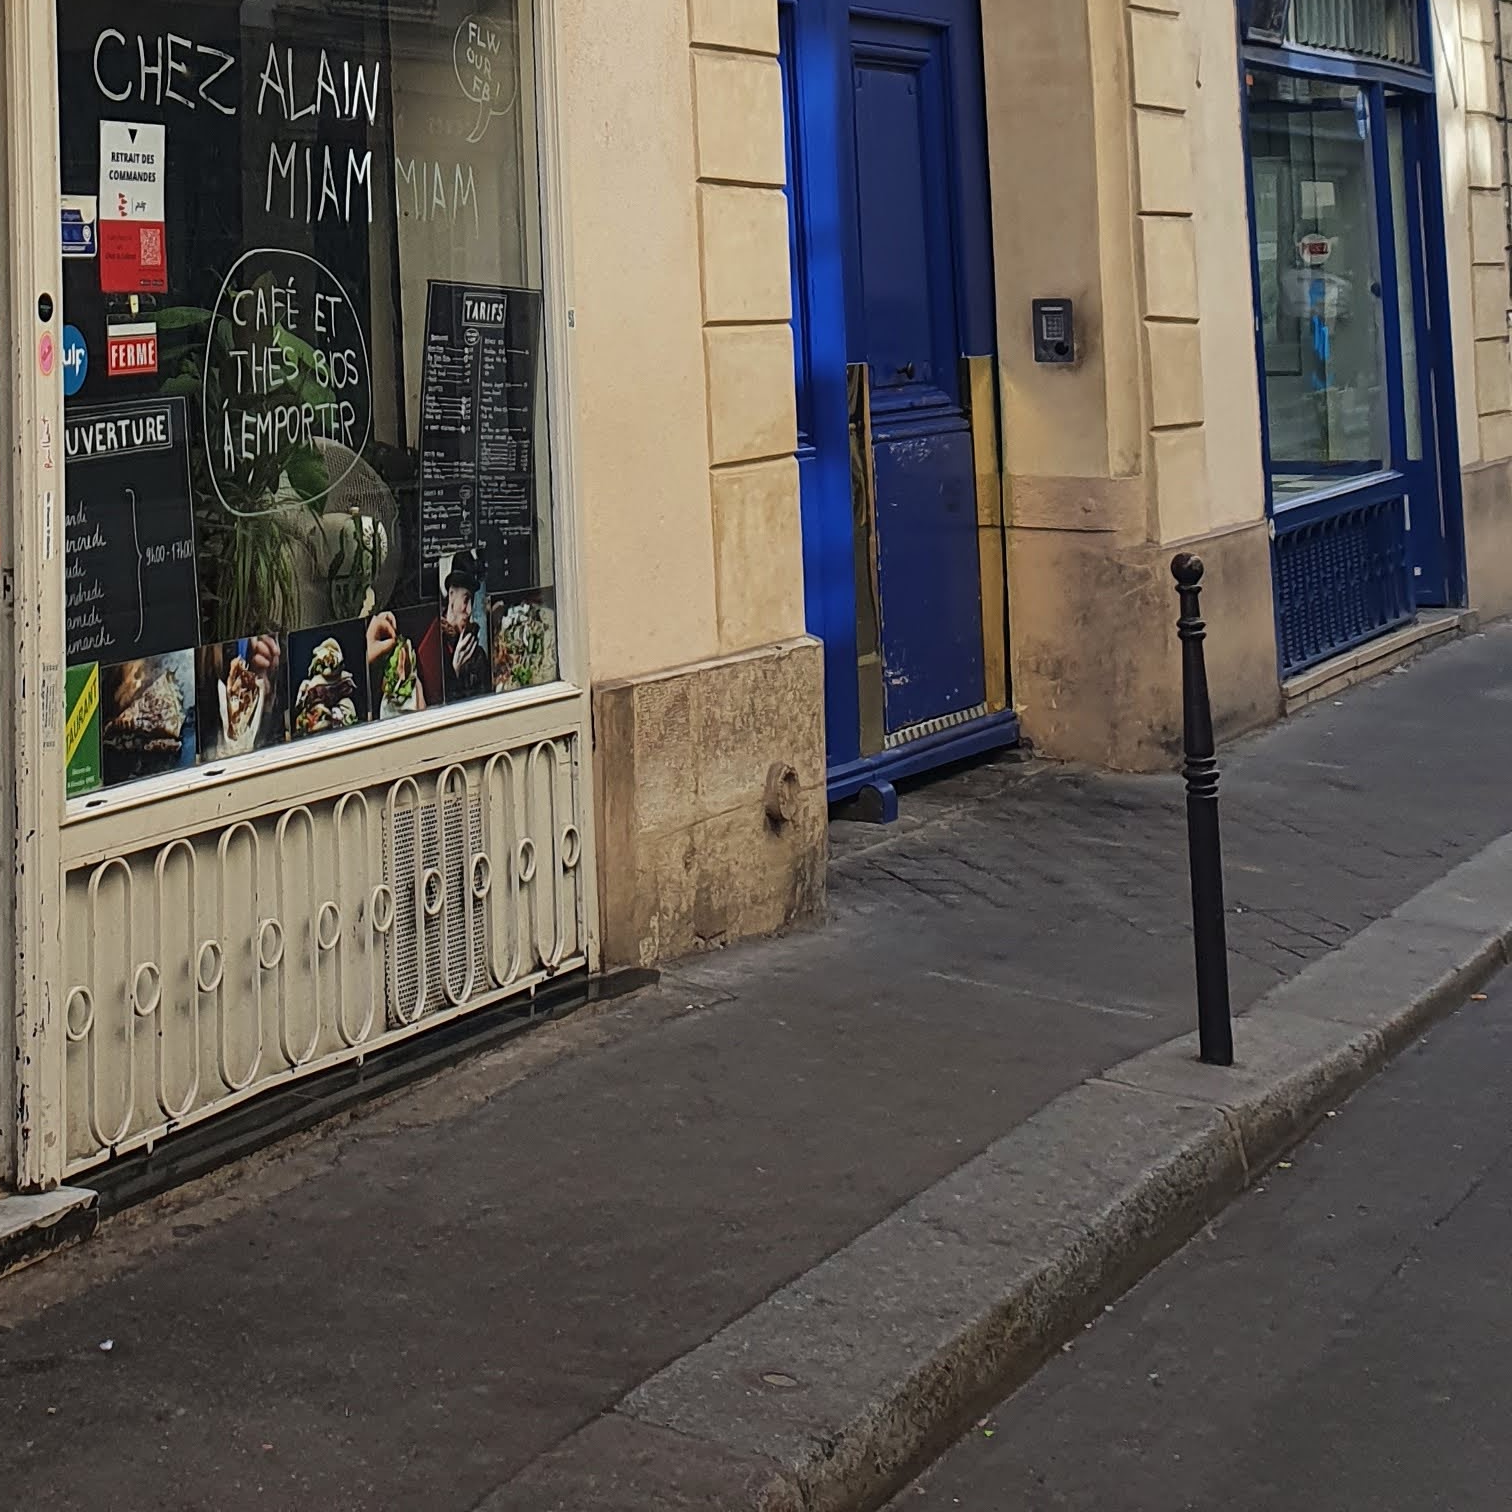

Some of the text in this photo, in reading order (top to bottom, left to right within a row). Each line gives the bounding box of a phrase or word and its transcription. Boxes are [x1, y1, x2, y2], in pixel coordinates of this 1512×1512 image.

[93, 27, 381, 127] CHEZ ALAIN
[466, 46, 492, 81] OUR
[110, 151, 155, 165] RETRAIT DES
[108, 169, 157, 183] COMMANDES
[265, 140, 479, 236] MIAM MIAM
[232, 276, 343, 338] CAFÉ ET
[465, 300, 504, 322] TARIFS
[110, 340, 156, 369] FERMÉ
[228, 331, 300, 396] THÉS
[312, 336, 359, 389] BIOS
